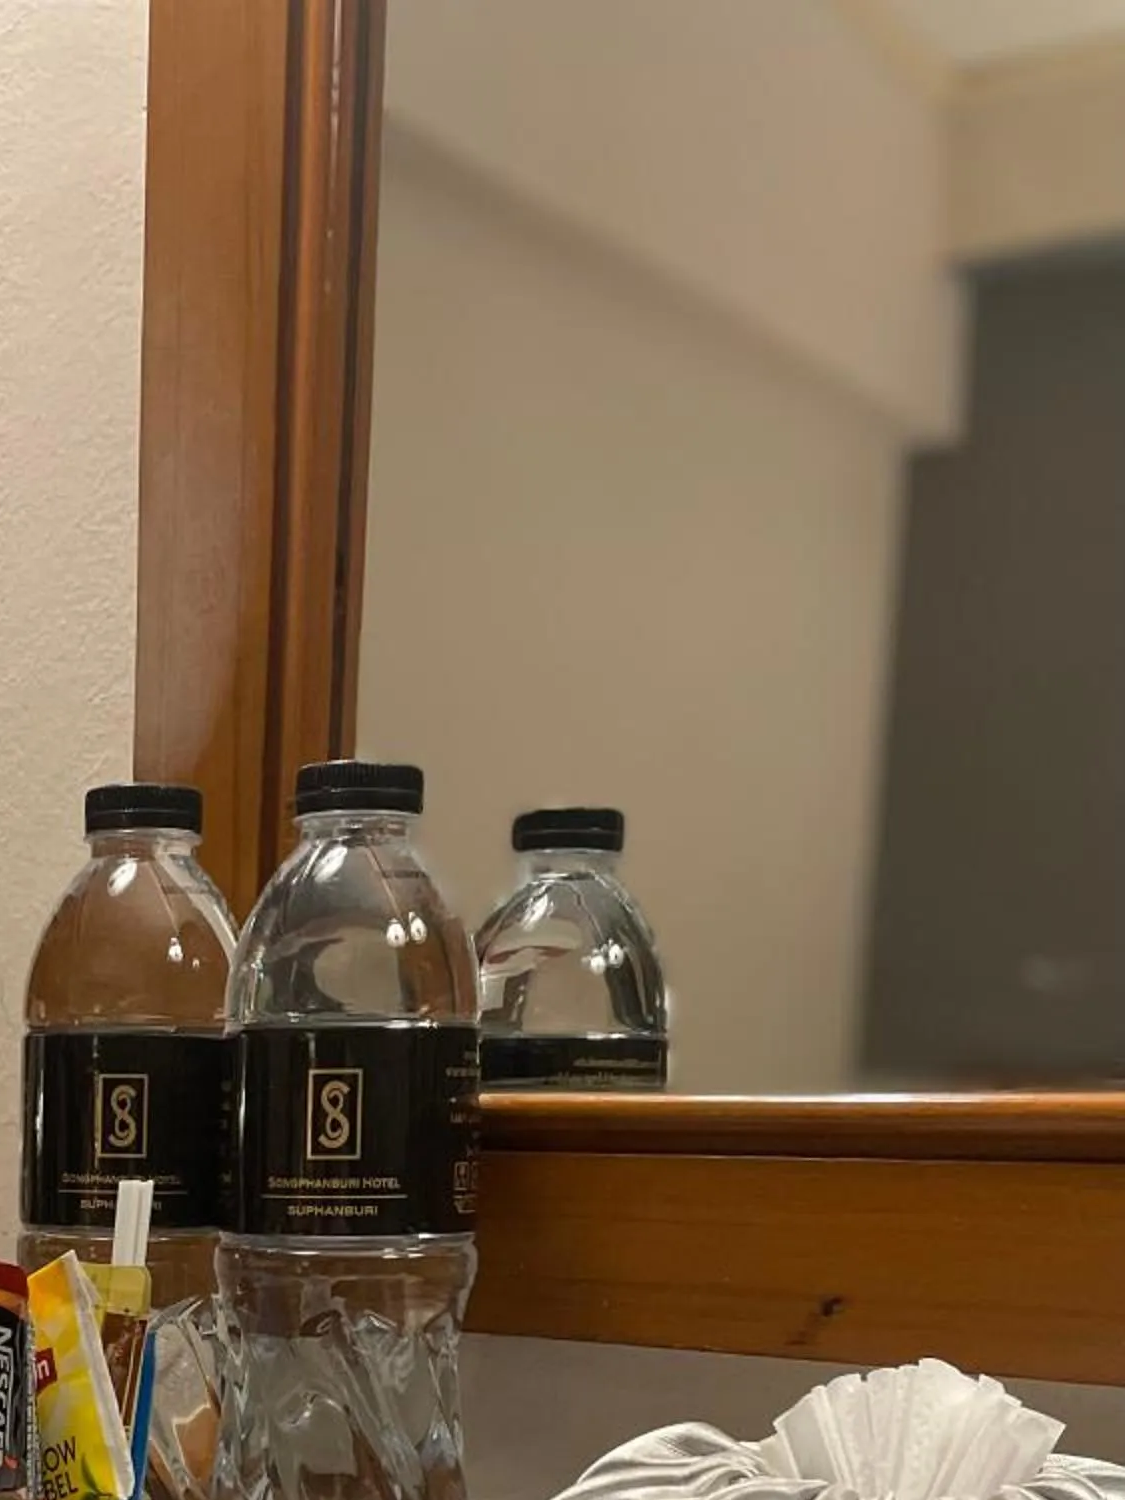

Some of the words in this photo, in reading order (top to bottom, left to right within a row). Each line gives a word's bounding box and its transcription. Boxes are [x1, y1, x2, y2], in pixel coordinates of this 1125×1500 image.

[267, 1176, 360, 1190] SONGPHANBURI
[362, 1177, 401, 1190] HOTEL
[286, 1204, 378, 1217] SUPHANBURI
